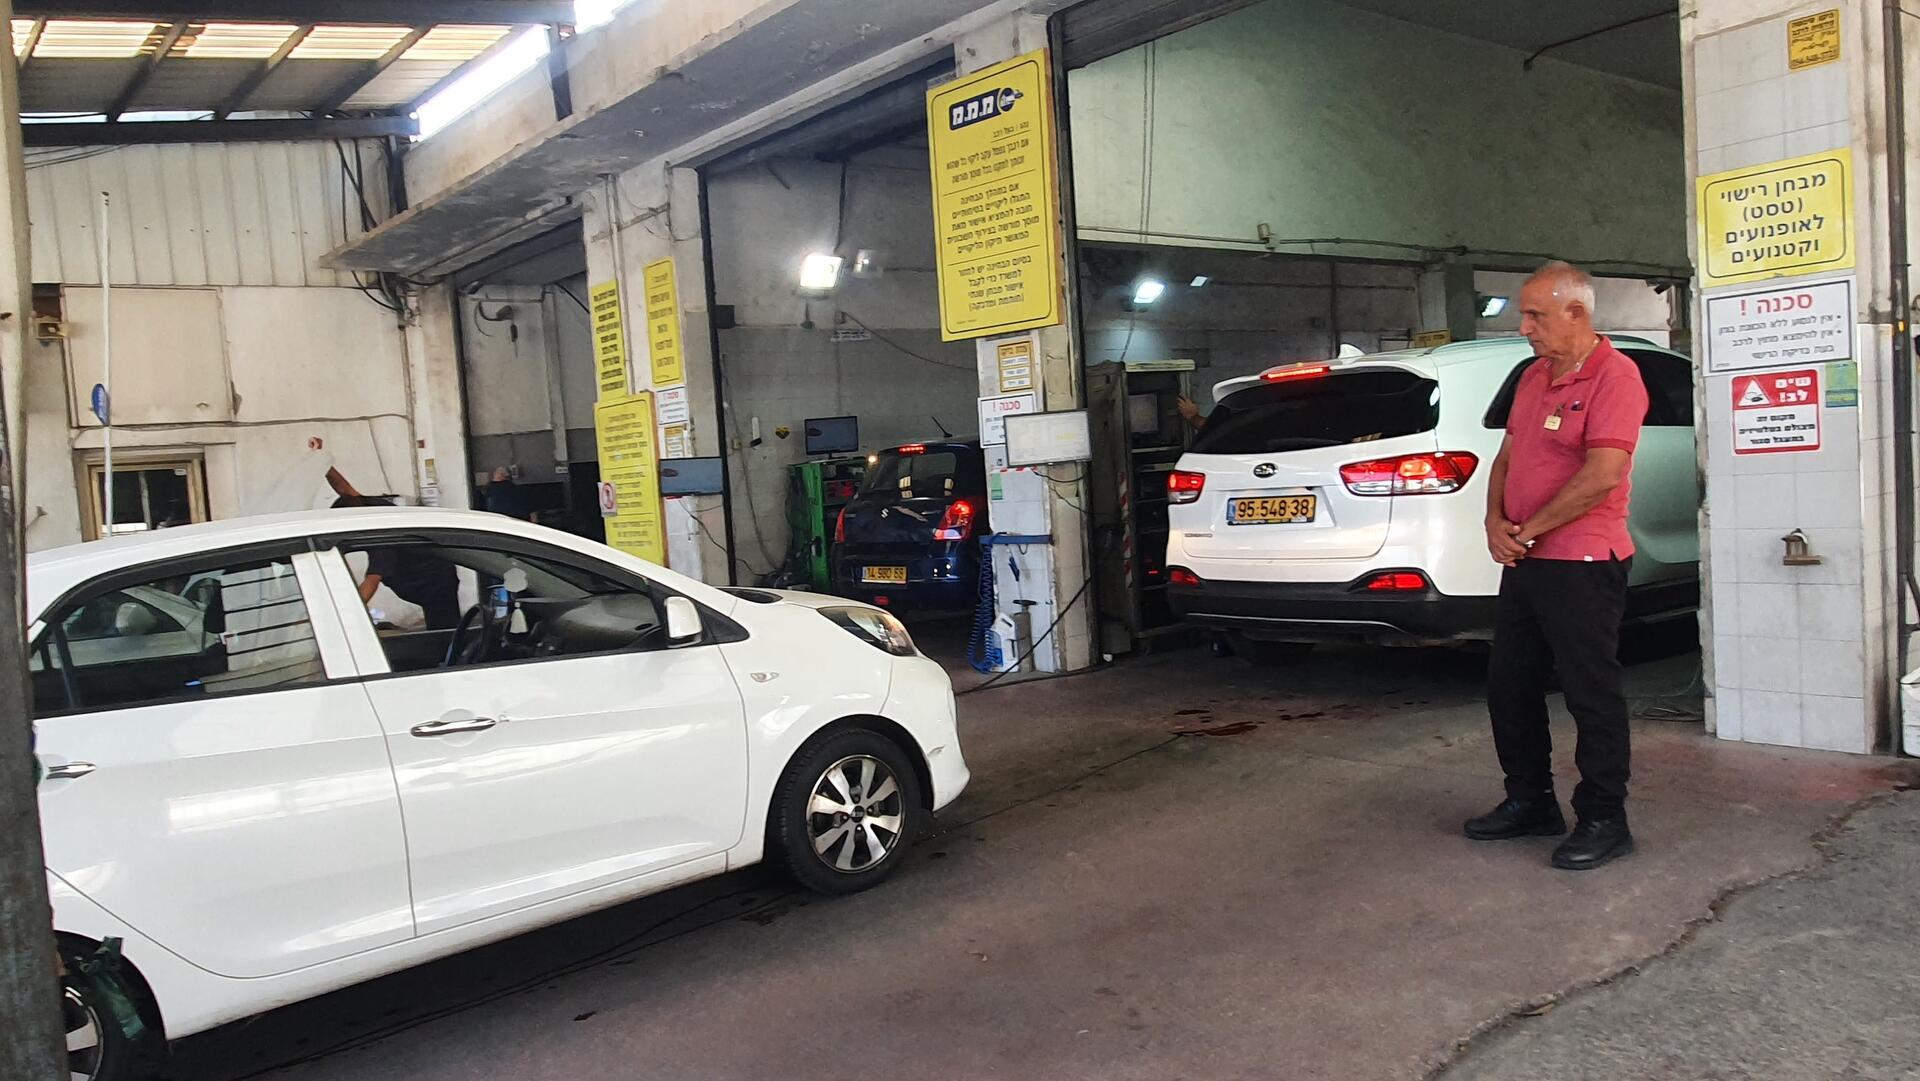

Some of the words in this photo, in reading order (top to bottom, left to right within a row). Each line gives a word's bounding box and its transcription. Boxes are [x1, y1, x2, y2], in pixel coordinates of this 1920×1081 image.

[1009, 183, 1020, 192] אם
[1776, 173, 1826, 198] מבחן
[960, 193, 984, 205] הבחינה
[1721, 184, 1768, 203] רישוי
[988, 209, 1014, 222] להמציא
[1743, 197, 1804, 222] (טסט)
[952, 221, 967, 231] מאת
[968, 217, 986, 227] אישור
[998, 220, 1020, 232] מורשה
[1022, 215, 1040, 228] מוסך
[974, 226, 997, 239] בצירוף
[1725, 213, 1825, 244] לאופנועים
[1732, 239, 1819, 264] וקטנועים
[986, 260, 1010, 272] הבחינה
[1012, 255, 1032, 266] בסיום
[986, 274, 997, 283] כדי
[999, 269, 1022, 281] למשרד
[968, 276, 985, 287] לקבל
[1740, 299, 1747, 316] !
[1756, 294, 1813, 314] סכנה
[1769, 319, 1788, 328] ללא
[1791, 315, 1817, 327] לנסוע
[1820, 314, 1833, 325] אין
[1820, 329, 1834, 339] אין
[1732, 337, 1753, 347] לרכב
[1781, 347, 1811, 358] בדיקת
[1775, 376, 1812, 389] שים
[1779, 389, 1809, 403] לב!
[999, 400, 1021, 411] סכנה
[1784, 423, 1816, 431] מצולם
[1773, 435, 1805, 443] במעגל
